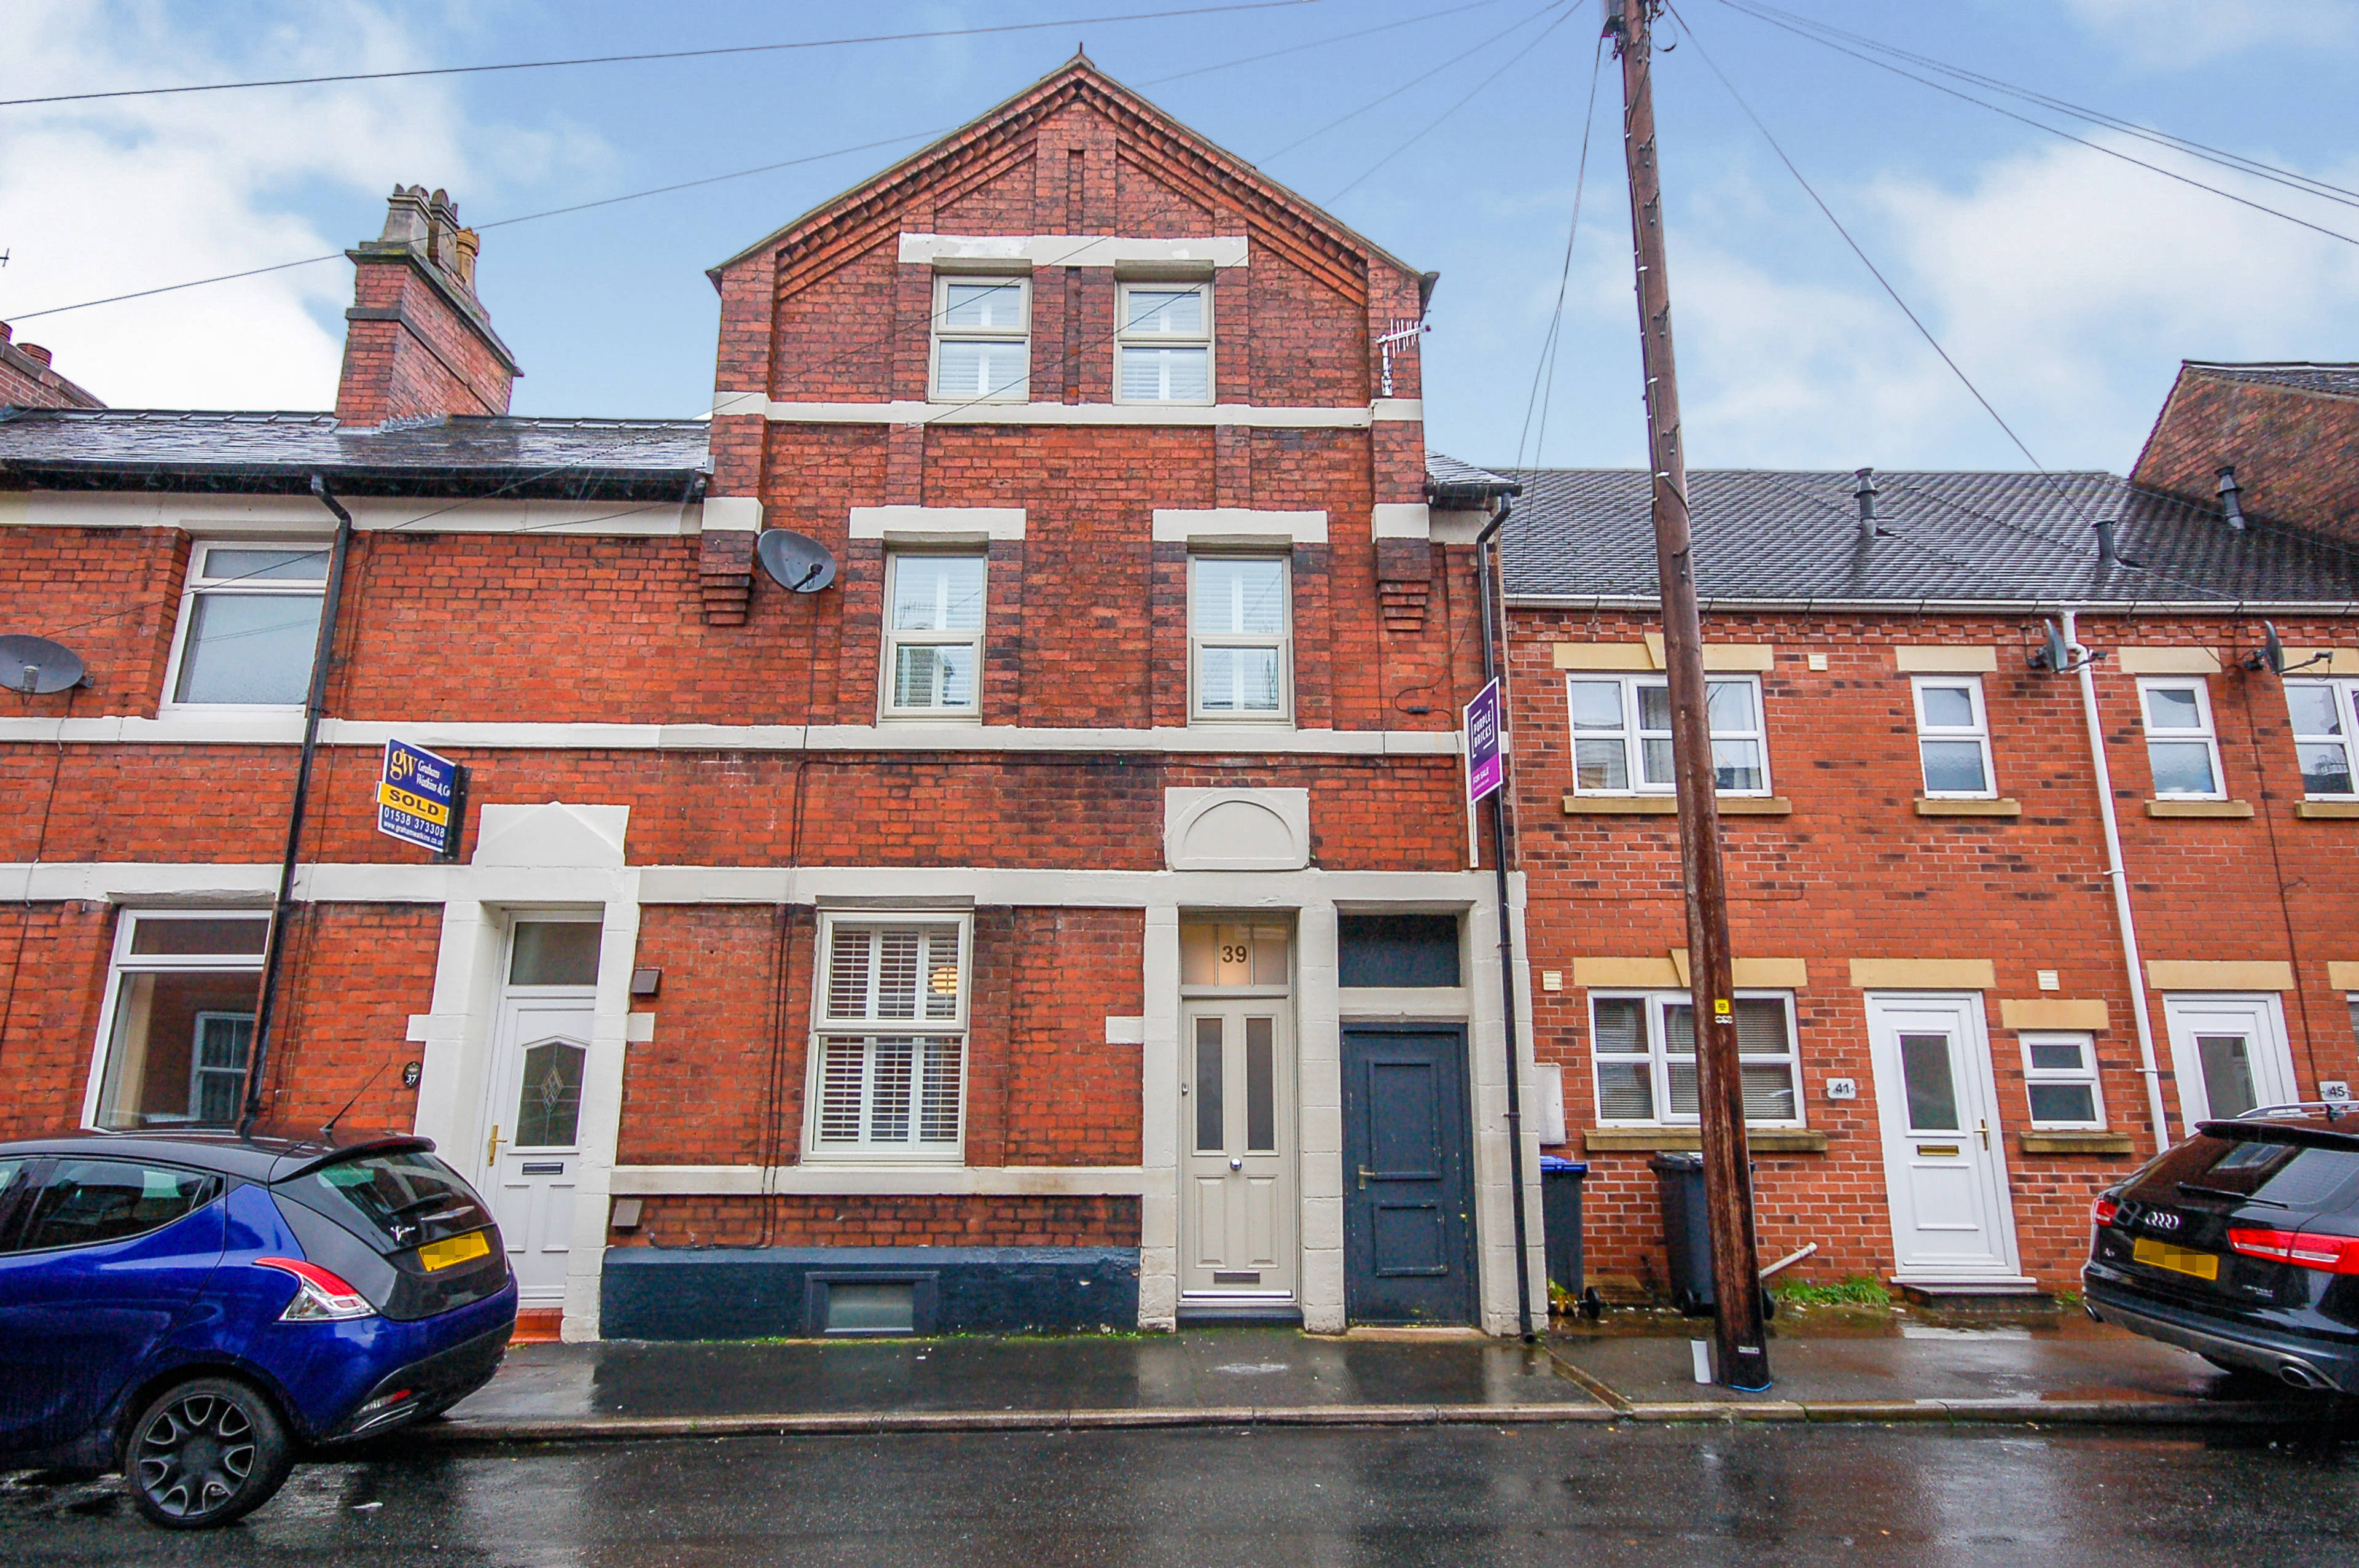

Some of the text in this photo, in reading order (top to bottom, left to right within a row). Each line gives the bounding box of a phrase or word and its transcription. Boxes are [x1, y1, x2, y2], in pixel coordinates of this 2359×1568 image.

[1474, 710, 1491, 735] PURPLE
[1474, 724, 1491, 747] BRICKS
[1481, 766, 1489, 779] SALE
[389, 789, 439, 816] SOLD
[384, 806, 444, 838] 01538 373308
[1223, 945, 1247, 963] 39
[406, 1074, 417, 1083] 37
[1835, 1083, 1849, 1093] 41
[2330, 1086, 2345, 1097] 45
